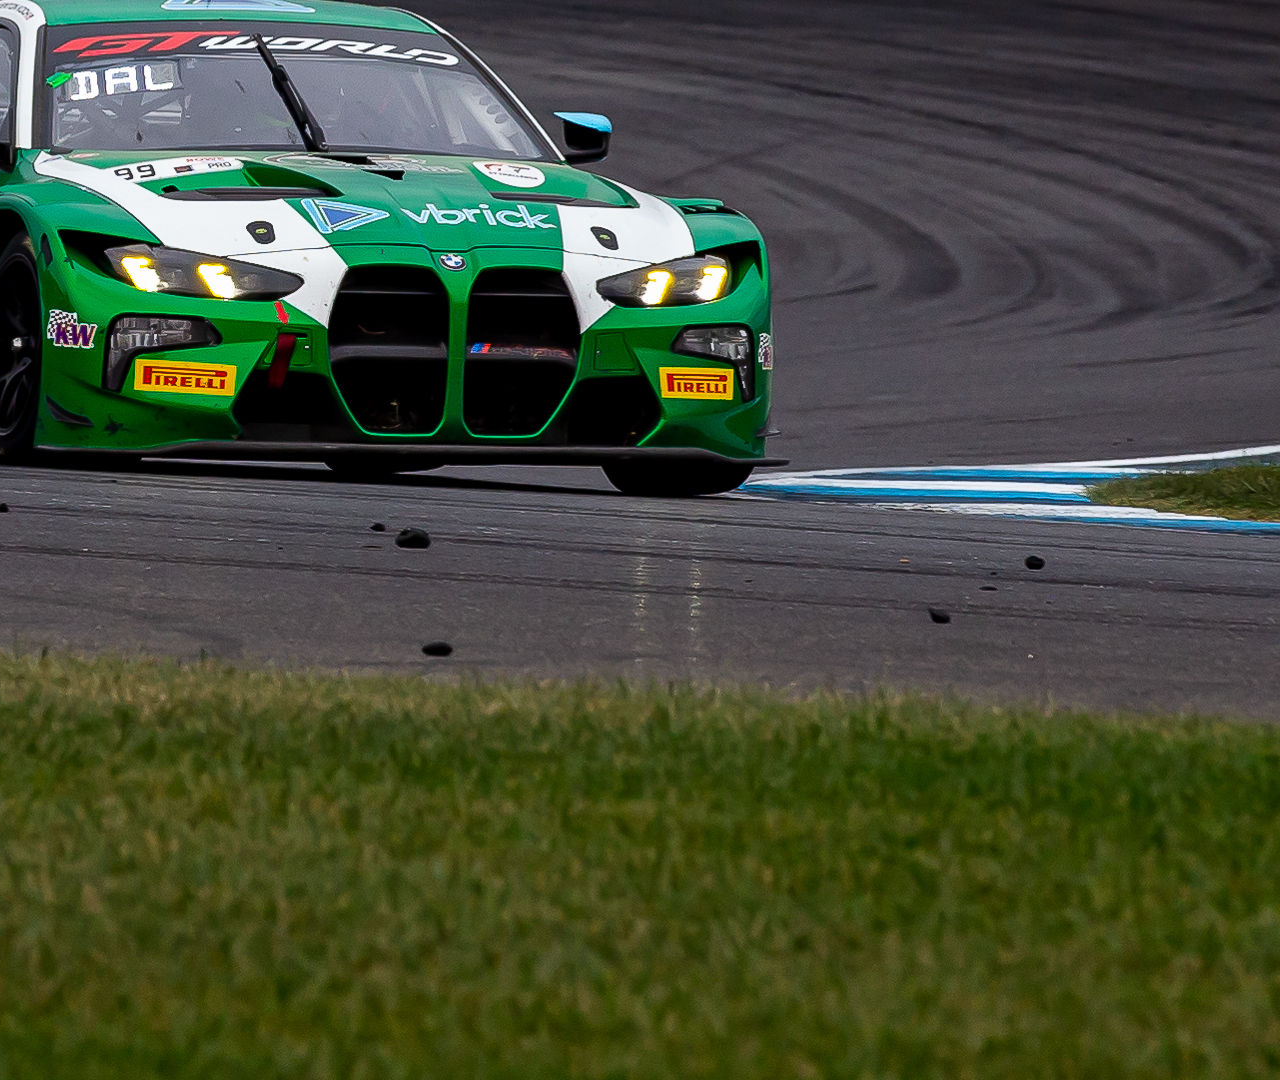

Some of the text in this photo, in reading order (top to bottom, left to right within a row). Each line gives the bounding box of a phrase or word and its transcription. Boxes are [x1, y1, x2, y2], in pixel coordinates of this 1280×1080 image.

[53, 30, 459, 66] GT WORLD
[70, 64, 174, 101] DAL
[114, 164, 156, 181] 99
[207, 161, 231, 169] PRO
[400, 203, 558, 229] vbrick
[54, 322, 97, 349] KW
[142, 365, 228, 390] PIRELLI
[666, 373, 728, 393] PIRELLI
